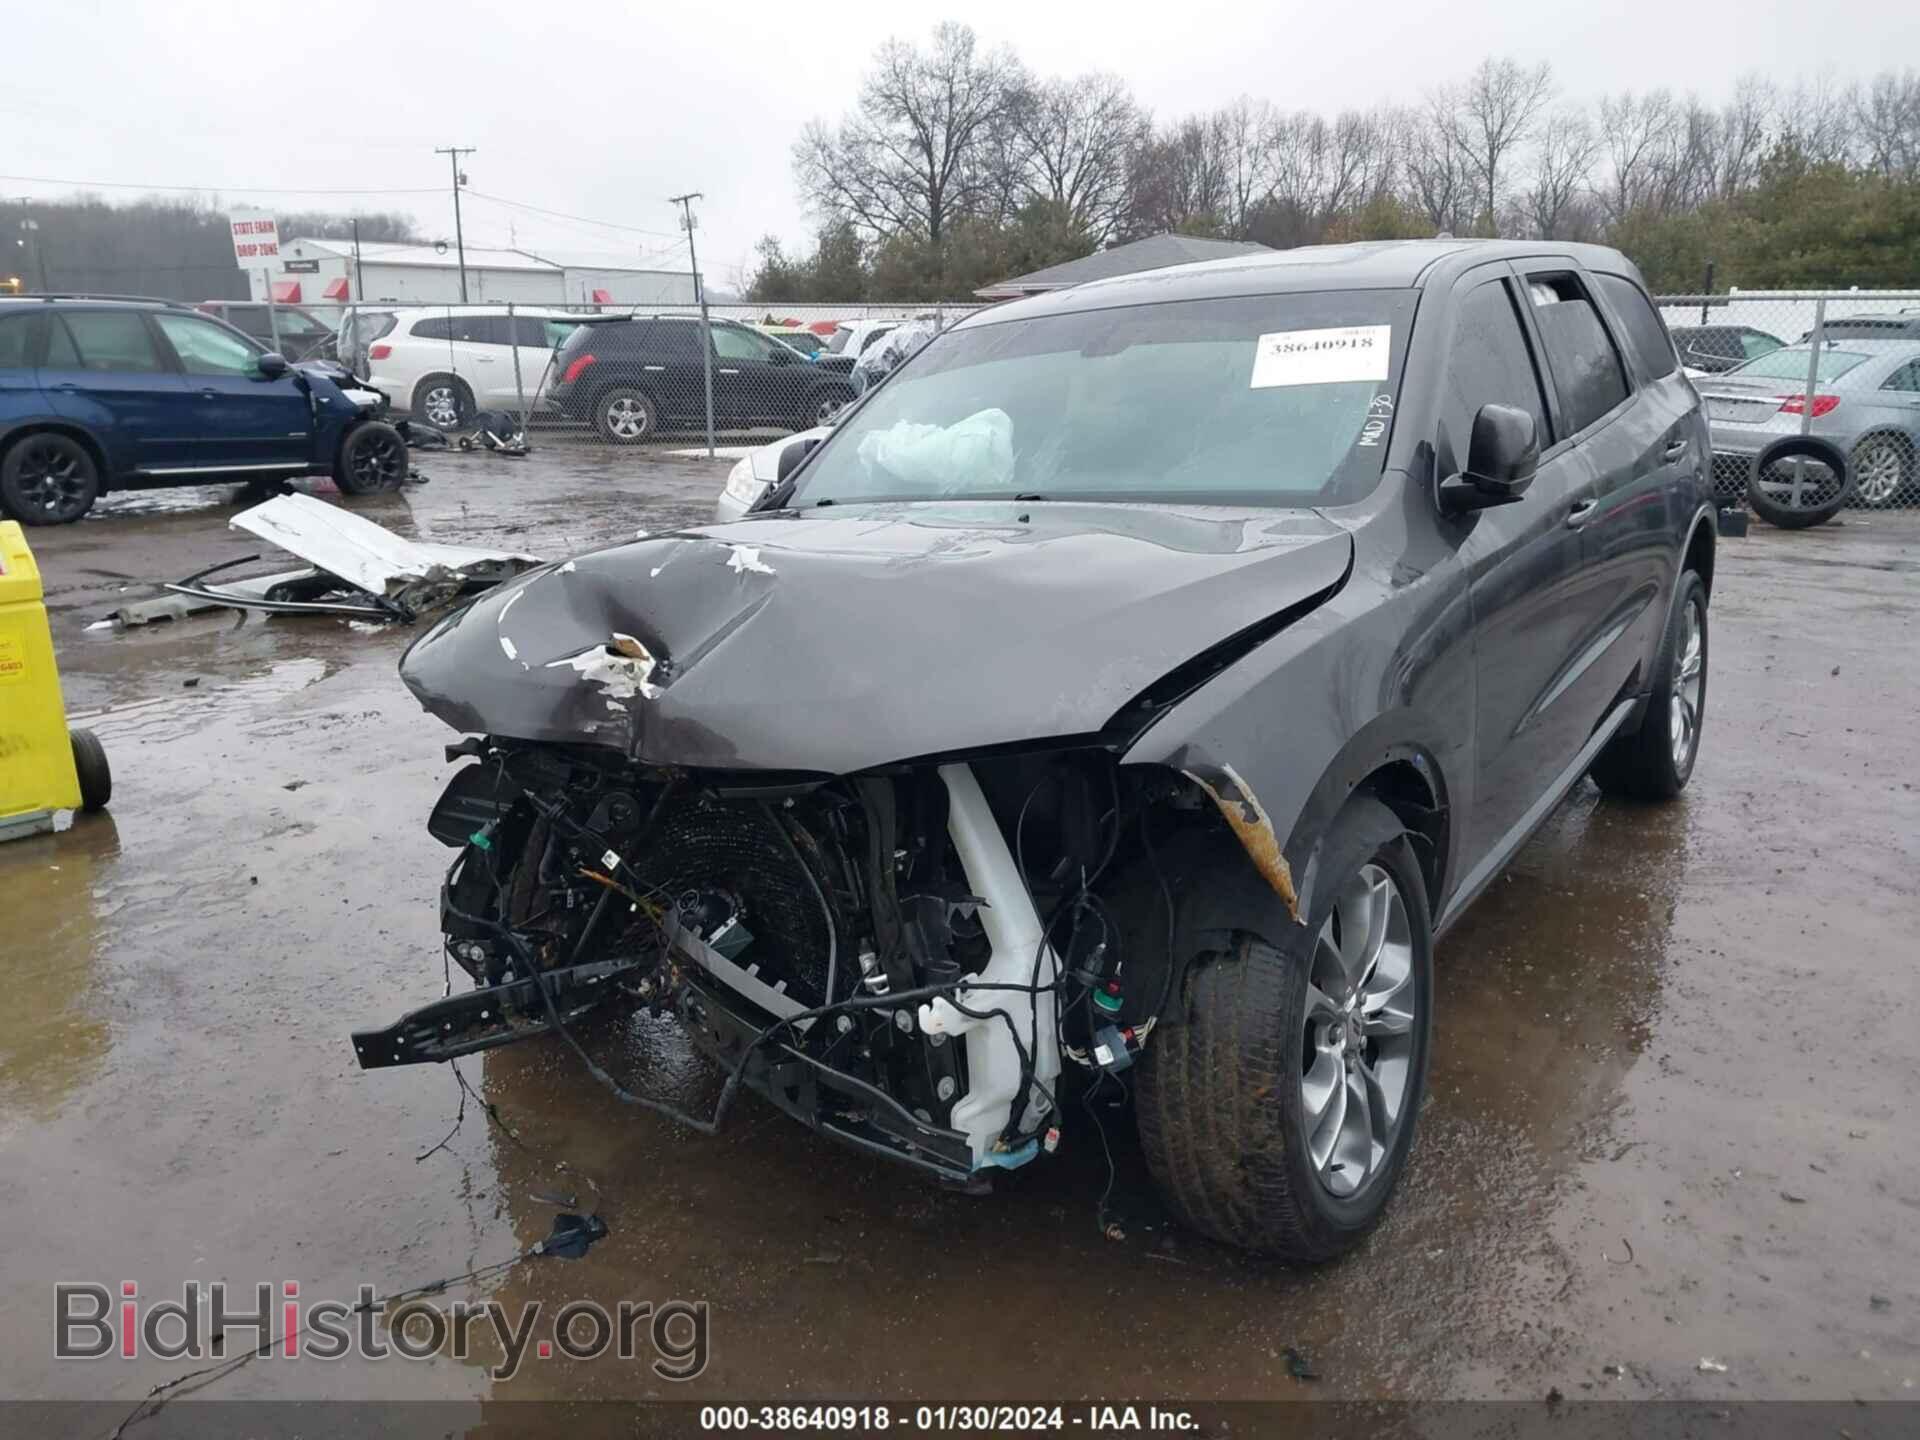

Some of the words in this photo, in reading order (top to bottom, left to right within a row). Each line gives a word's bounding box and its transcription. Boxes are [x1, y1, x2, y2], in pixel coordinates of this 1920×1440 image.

[233, 222, 254, 235] STATE
[255, 220, 275, 233] FARM
[237, 244, 257, 257] DROP
[259, 242, 278, 256] ZONE
[1271, 337, 1374, 355] 38640918
